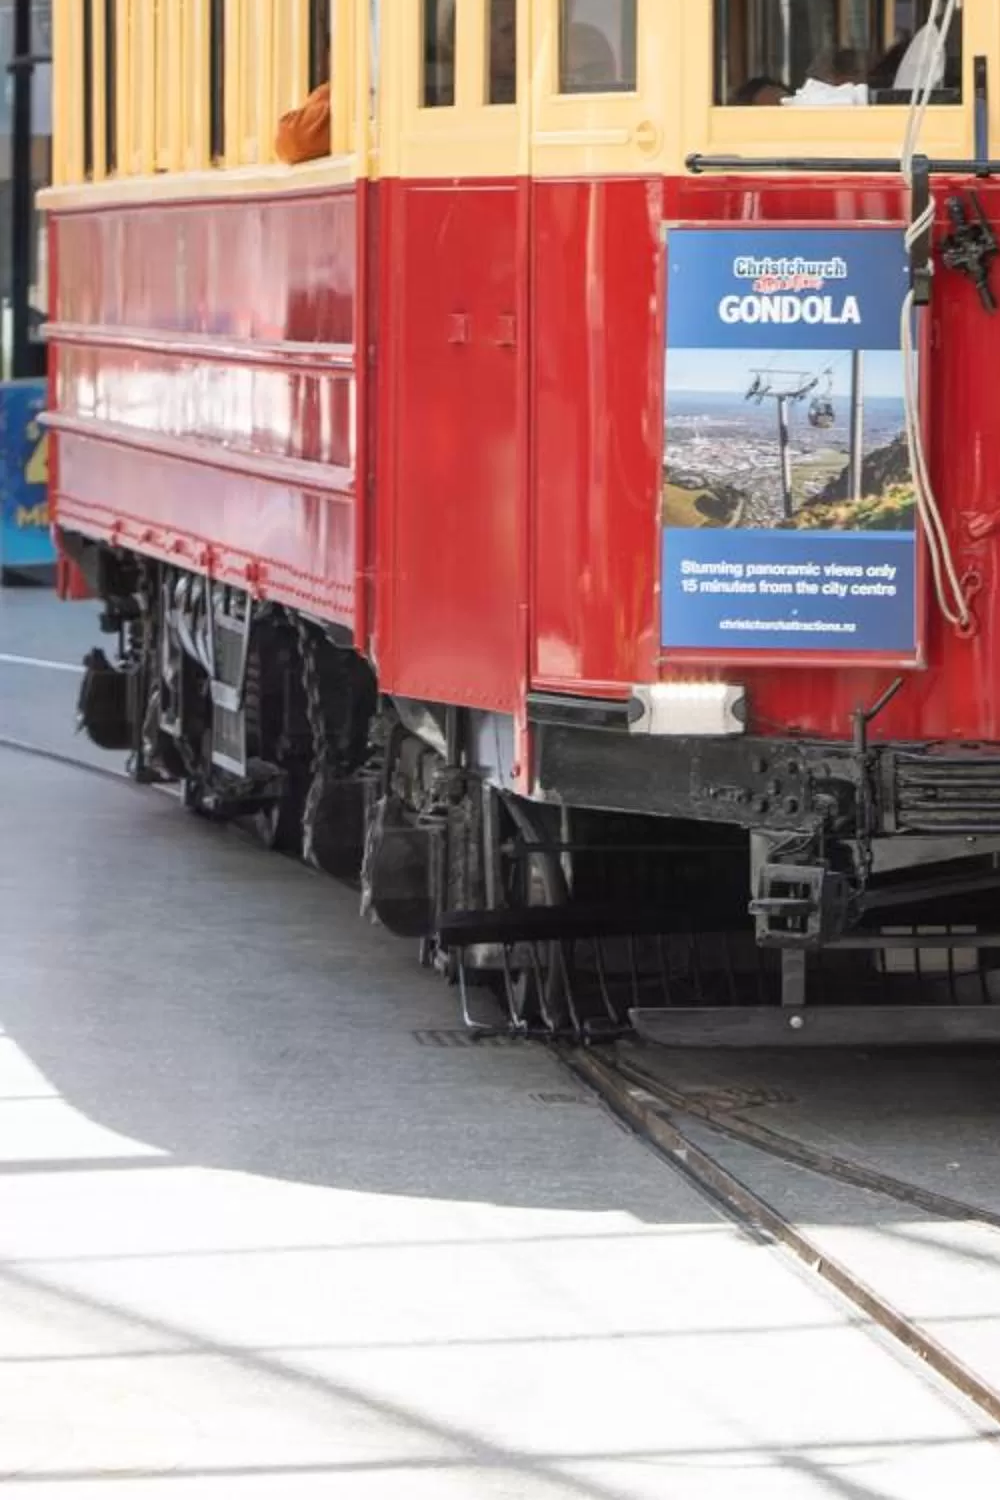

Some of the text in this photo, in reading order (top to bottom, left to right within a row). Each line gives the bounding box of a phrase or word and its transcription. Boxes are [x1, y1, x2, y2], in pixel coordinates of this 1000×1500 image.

[734, 256, 848, 278] Christchurch
[718, 295, 862, 325] GONDOLA
[681, 560, 896, 581] Stunning panoramic views only
[681, 578, 897, 599] 15 minutes from the city centre
